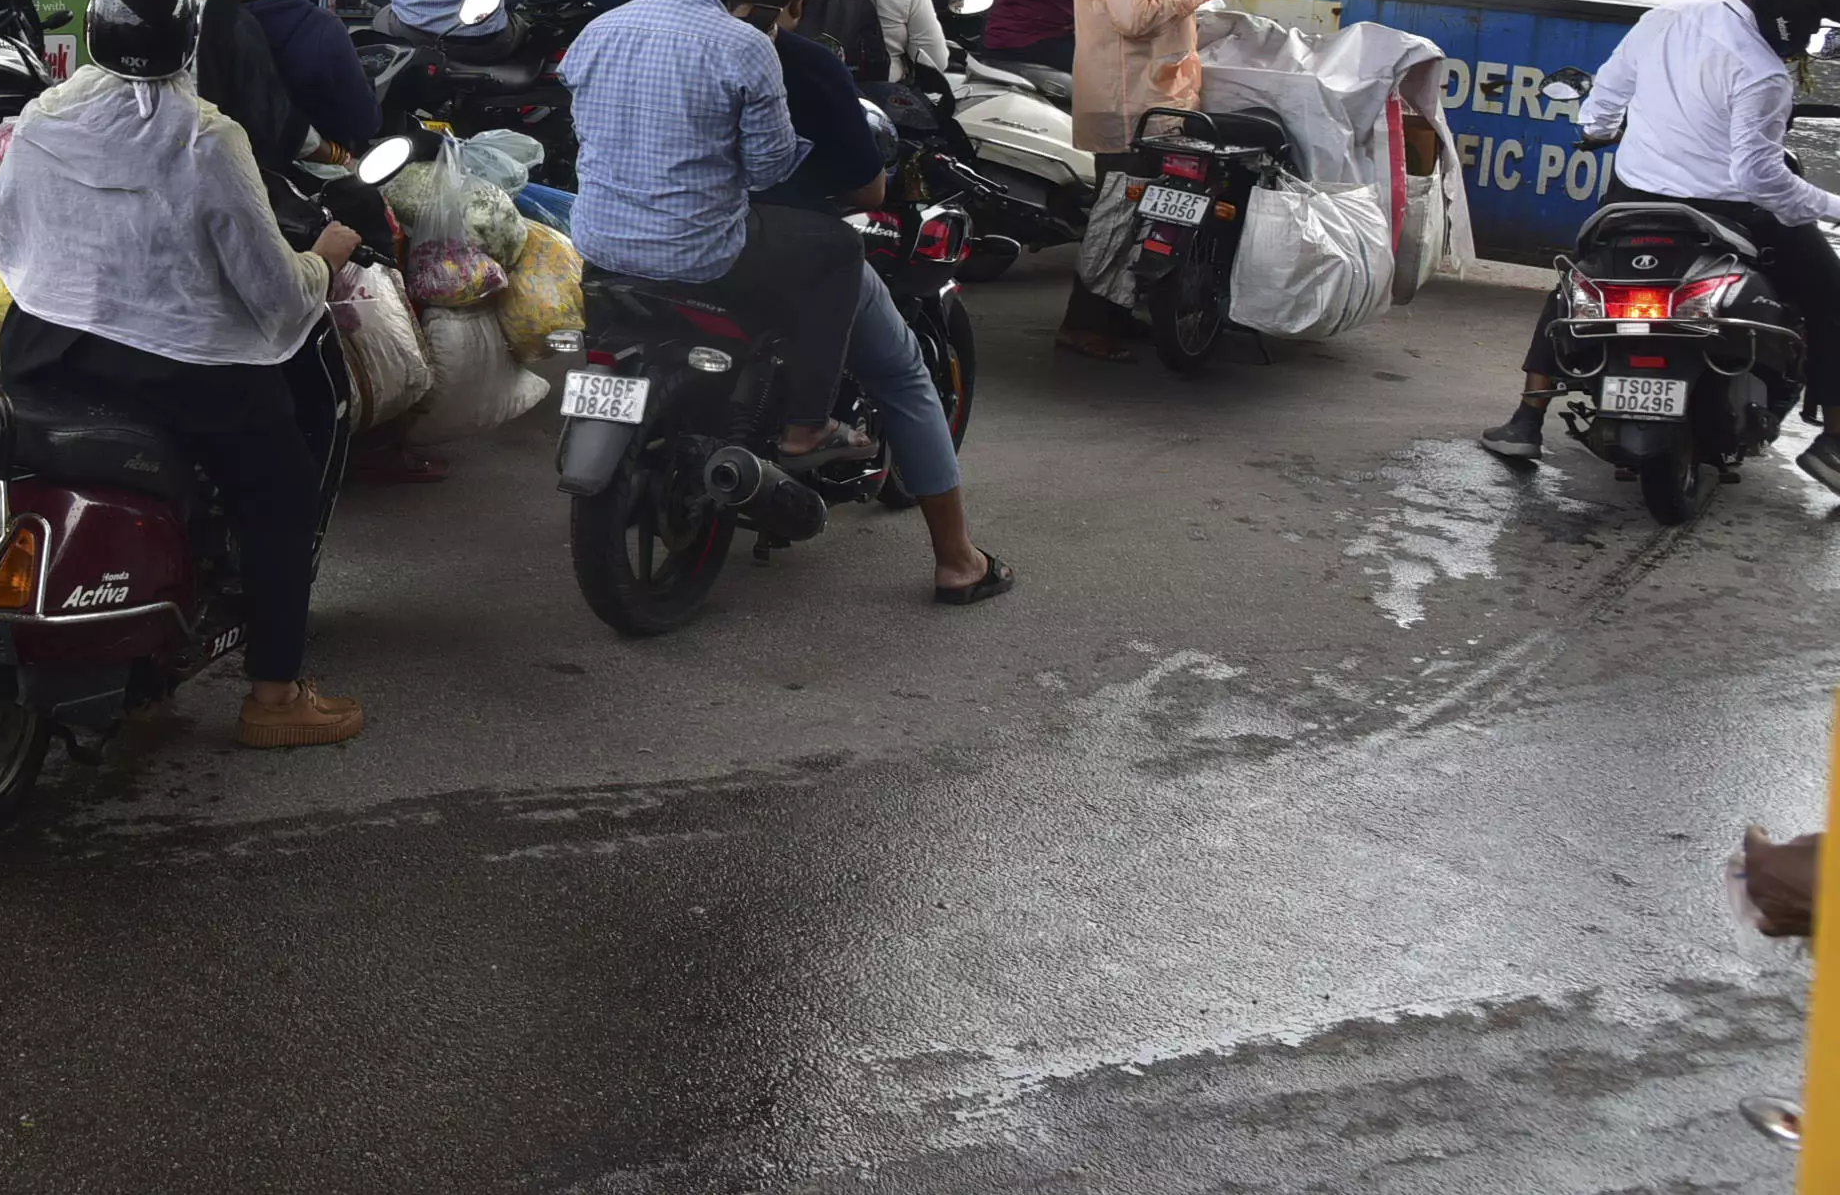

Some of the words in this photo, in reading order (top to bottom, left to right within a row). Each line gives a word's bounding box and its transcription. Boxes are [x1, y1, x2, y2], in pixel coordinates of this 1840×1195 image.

[42, 0, 66, 12] with
[1156, 188, 1202, 208] TS12F
[1149, 201, 1196, 220] A3050
[579, 375, 637, 400] TS06F
[1617, 378, 1676, 396] TS03F
[1615, 394, 1674, 412] D0496
[101, 571, 130, 582] Honda
[61, 582, 129, 608] Activa
